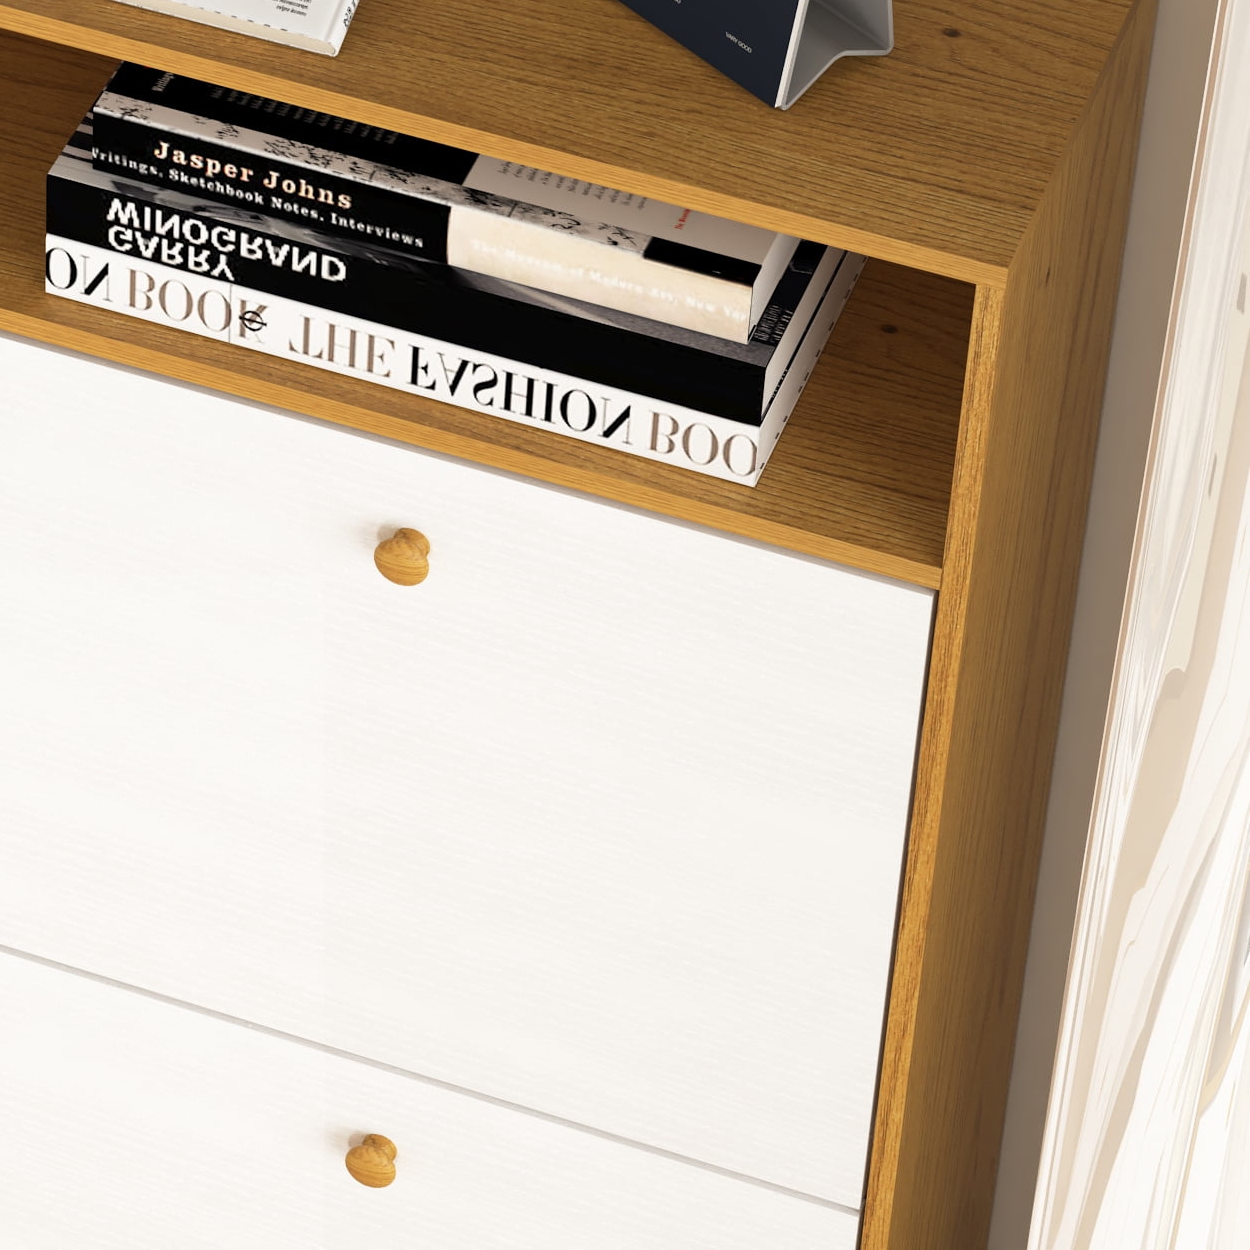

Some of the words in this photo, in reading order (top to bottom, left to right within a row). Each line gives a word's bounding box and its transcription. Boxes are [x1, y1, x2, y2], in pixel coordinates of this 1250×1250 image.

[153, 140, 254, 184] Jasper
[263, 170, 353, 211] Johns
[168, 168, 265, 206] Sketchbook
[330, 212, 424, 249] Interviews
